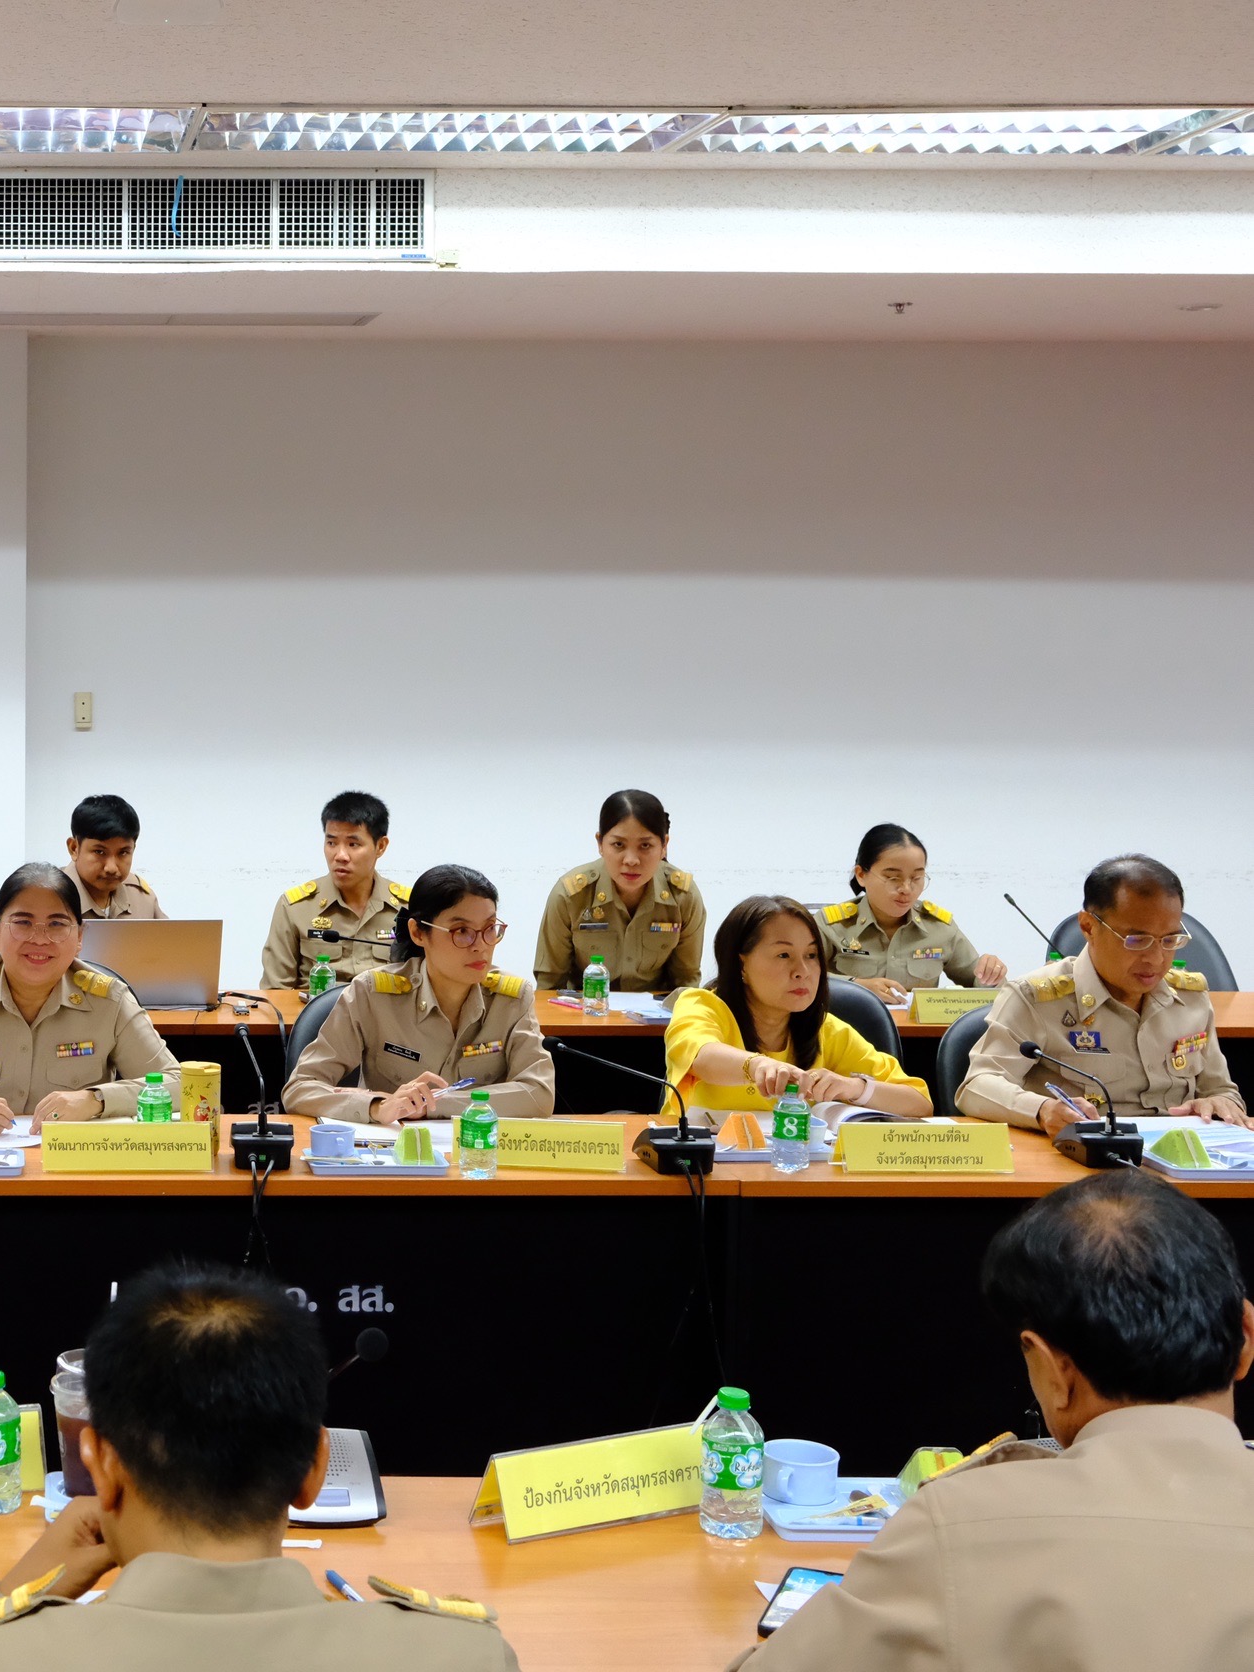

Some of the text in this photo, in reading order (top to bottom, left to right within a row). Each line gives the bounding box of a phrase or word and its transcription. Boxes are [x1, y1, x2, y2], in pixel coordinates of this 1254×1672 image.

[783, 1116, 798, 1137] 8
[882, 1127, 970, 1143] เจ้าพนักงานที่ดิน
[47, 1137, 207, 1155] พัฒนาการจังหวัดสมุทรสงคราม
[876, 1152, 984, 1169] จังหวัดสมุทรสงคราม
[338, 1285, 395, 1312] สส.
[523, 1465, 702, 1509] ป้องกันจังหวัดสมุทรสงครา
